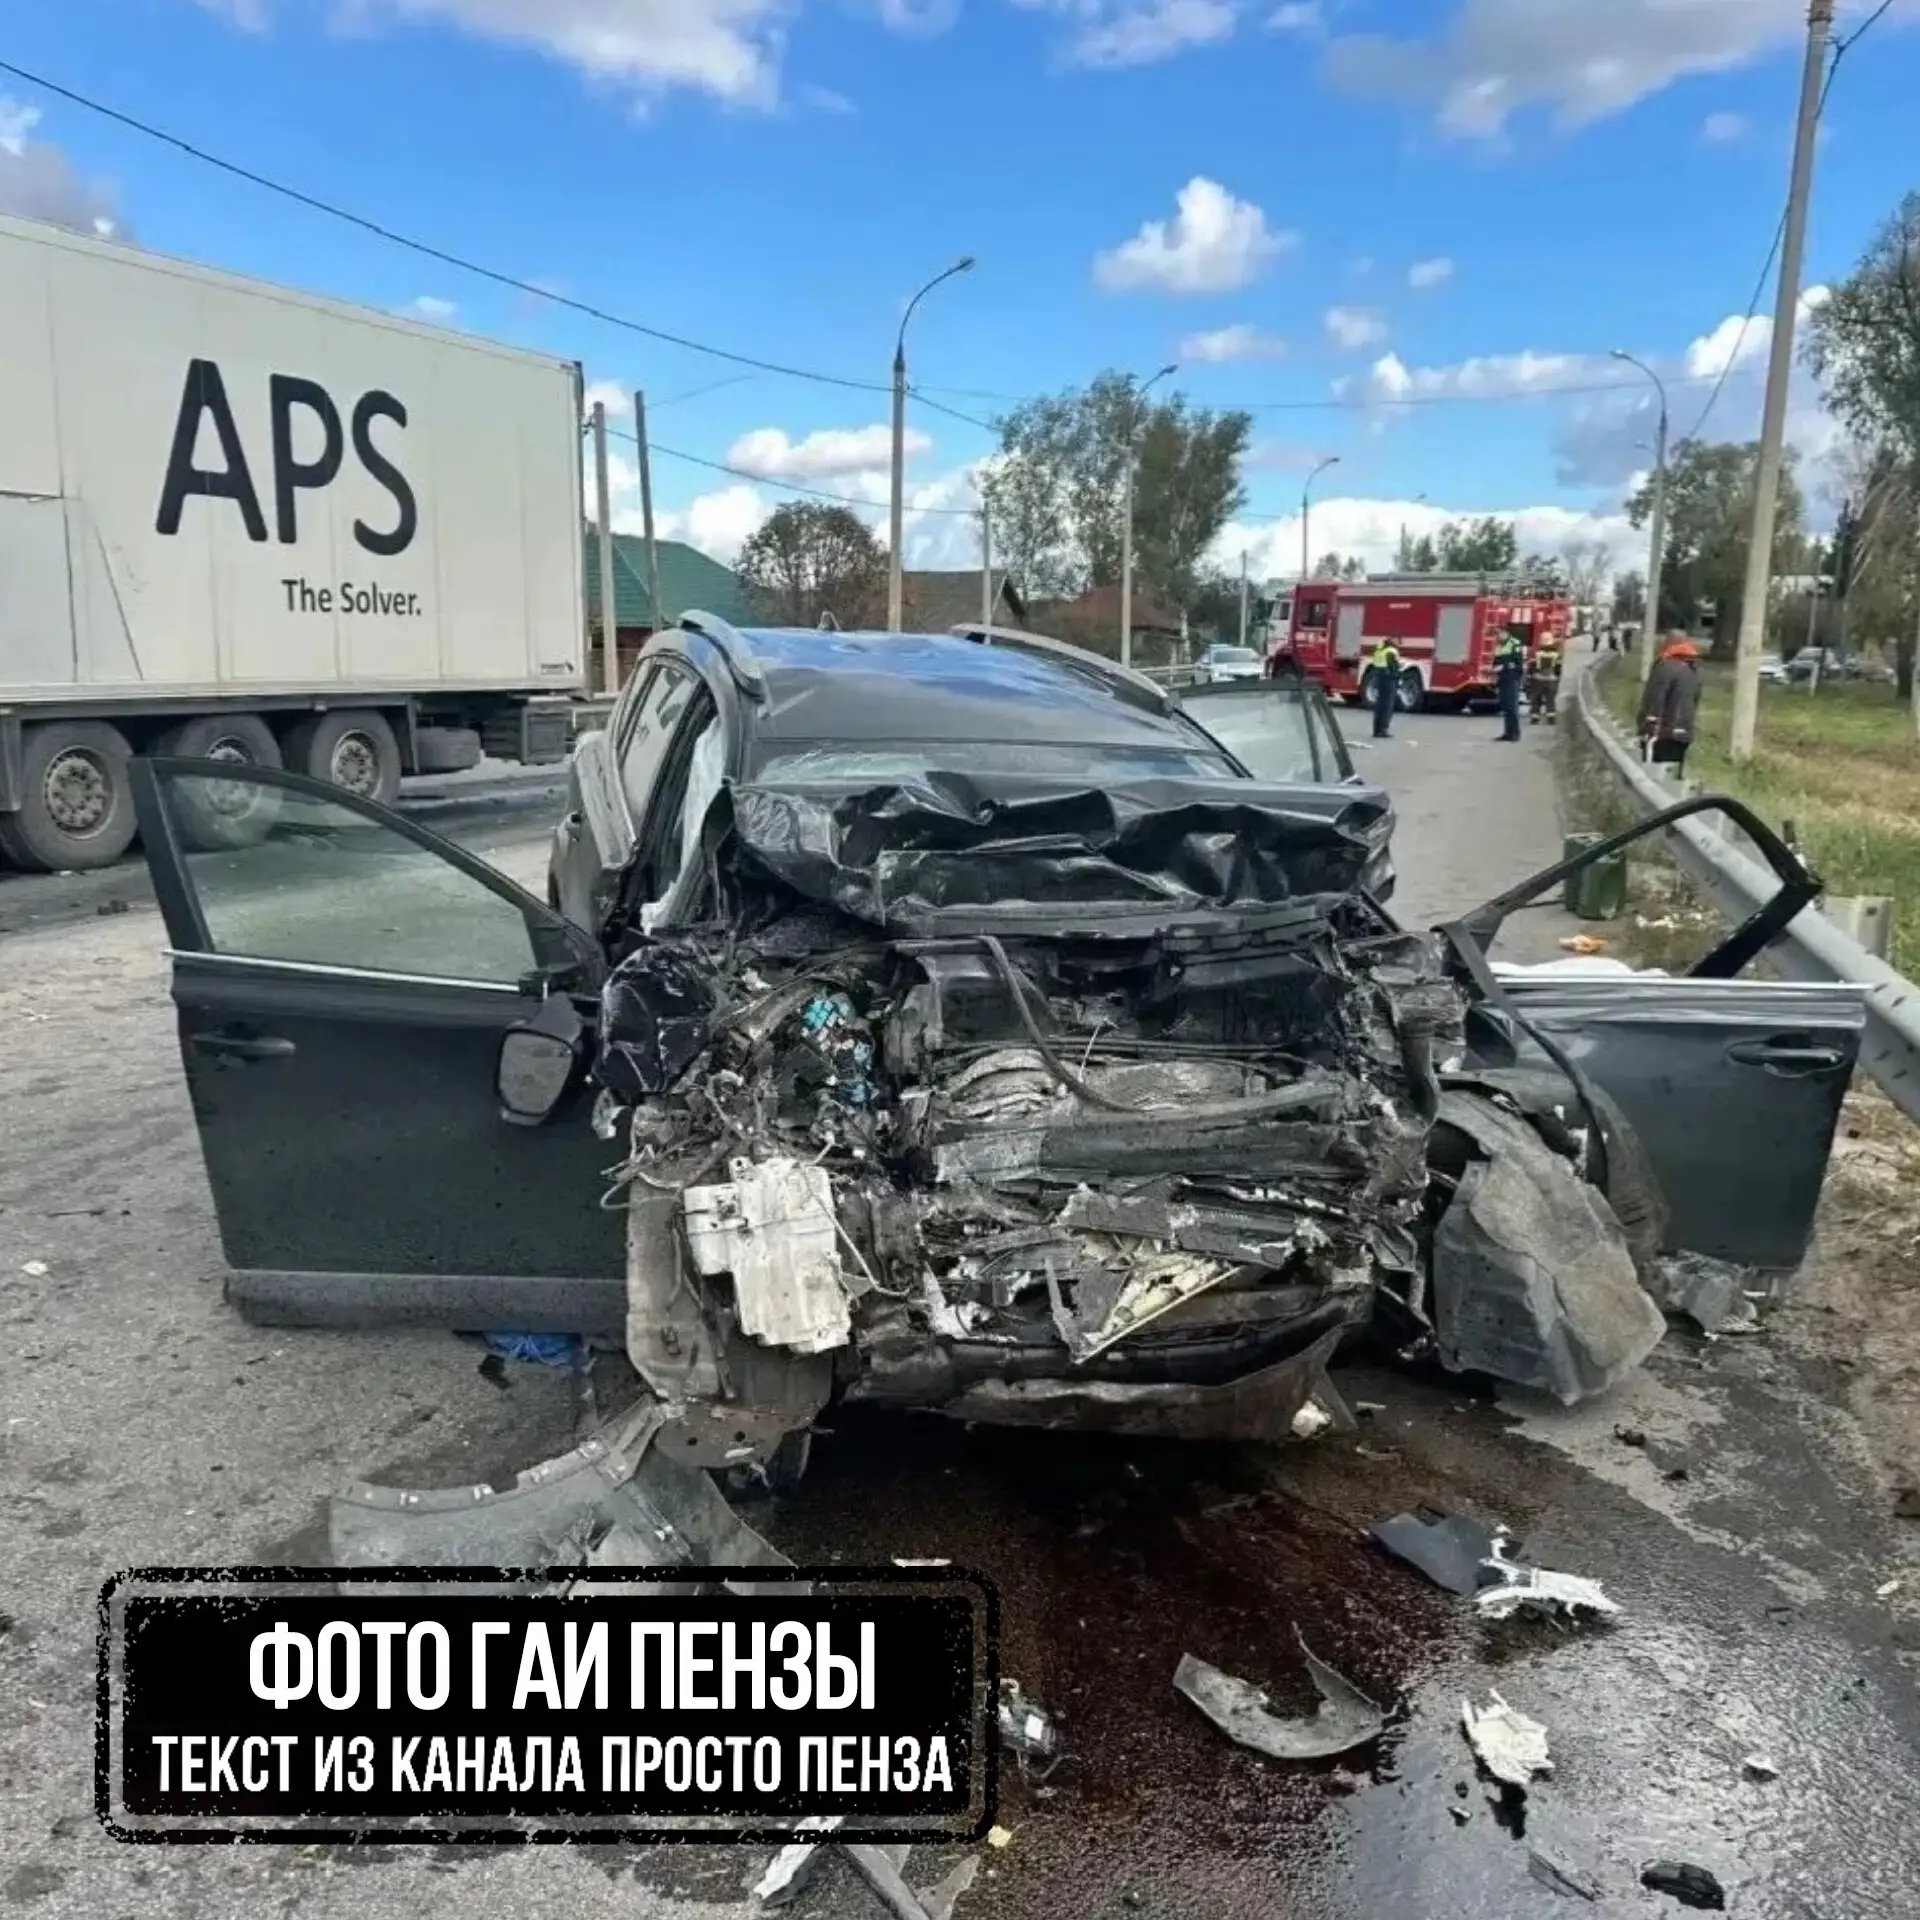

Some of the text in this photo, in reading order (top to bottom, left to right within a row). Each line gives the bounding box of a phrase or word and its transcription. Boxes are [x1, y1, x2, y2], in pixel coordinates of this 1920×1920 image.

[156, 358, 417, 556] APS
[281, 579, 422, 616] The Solver.
